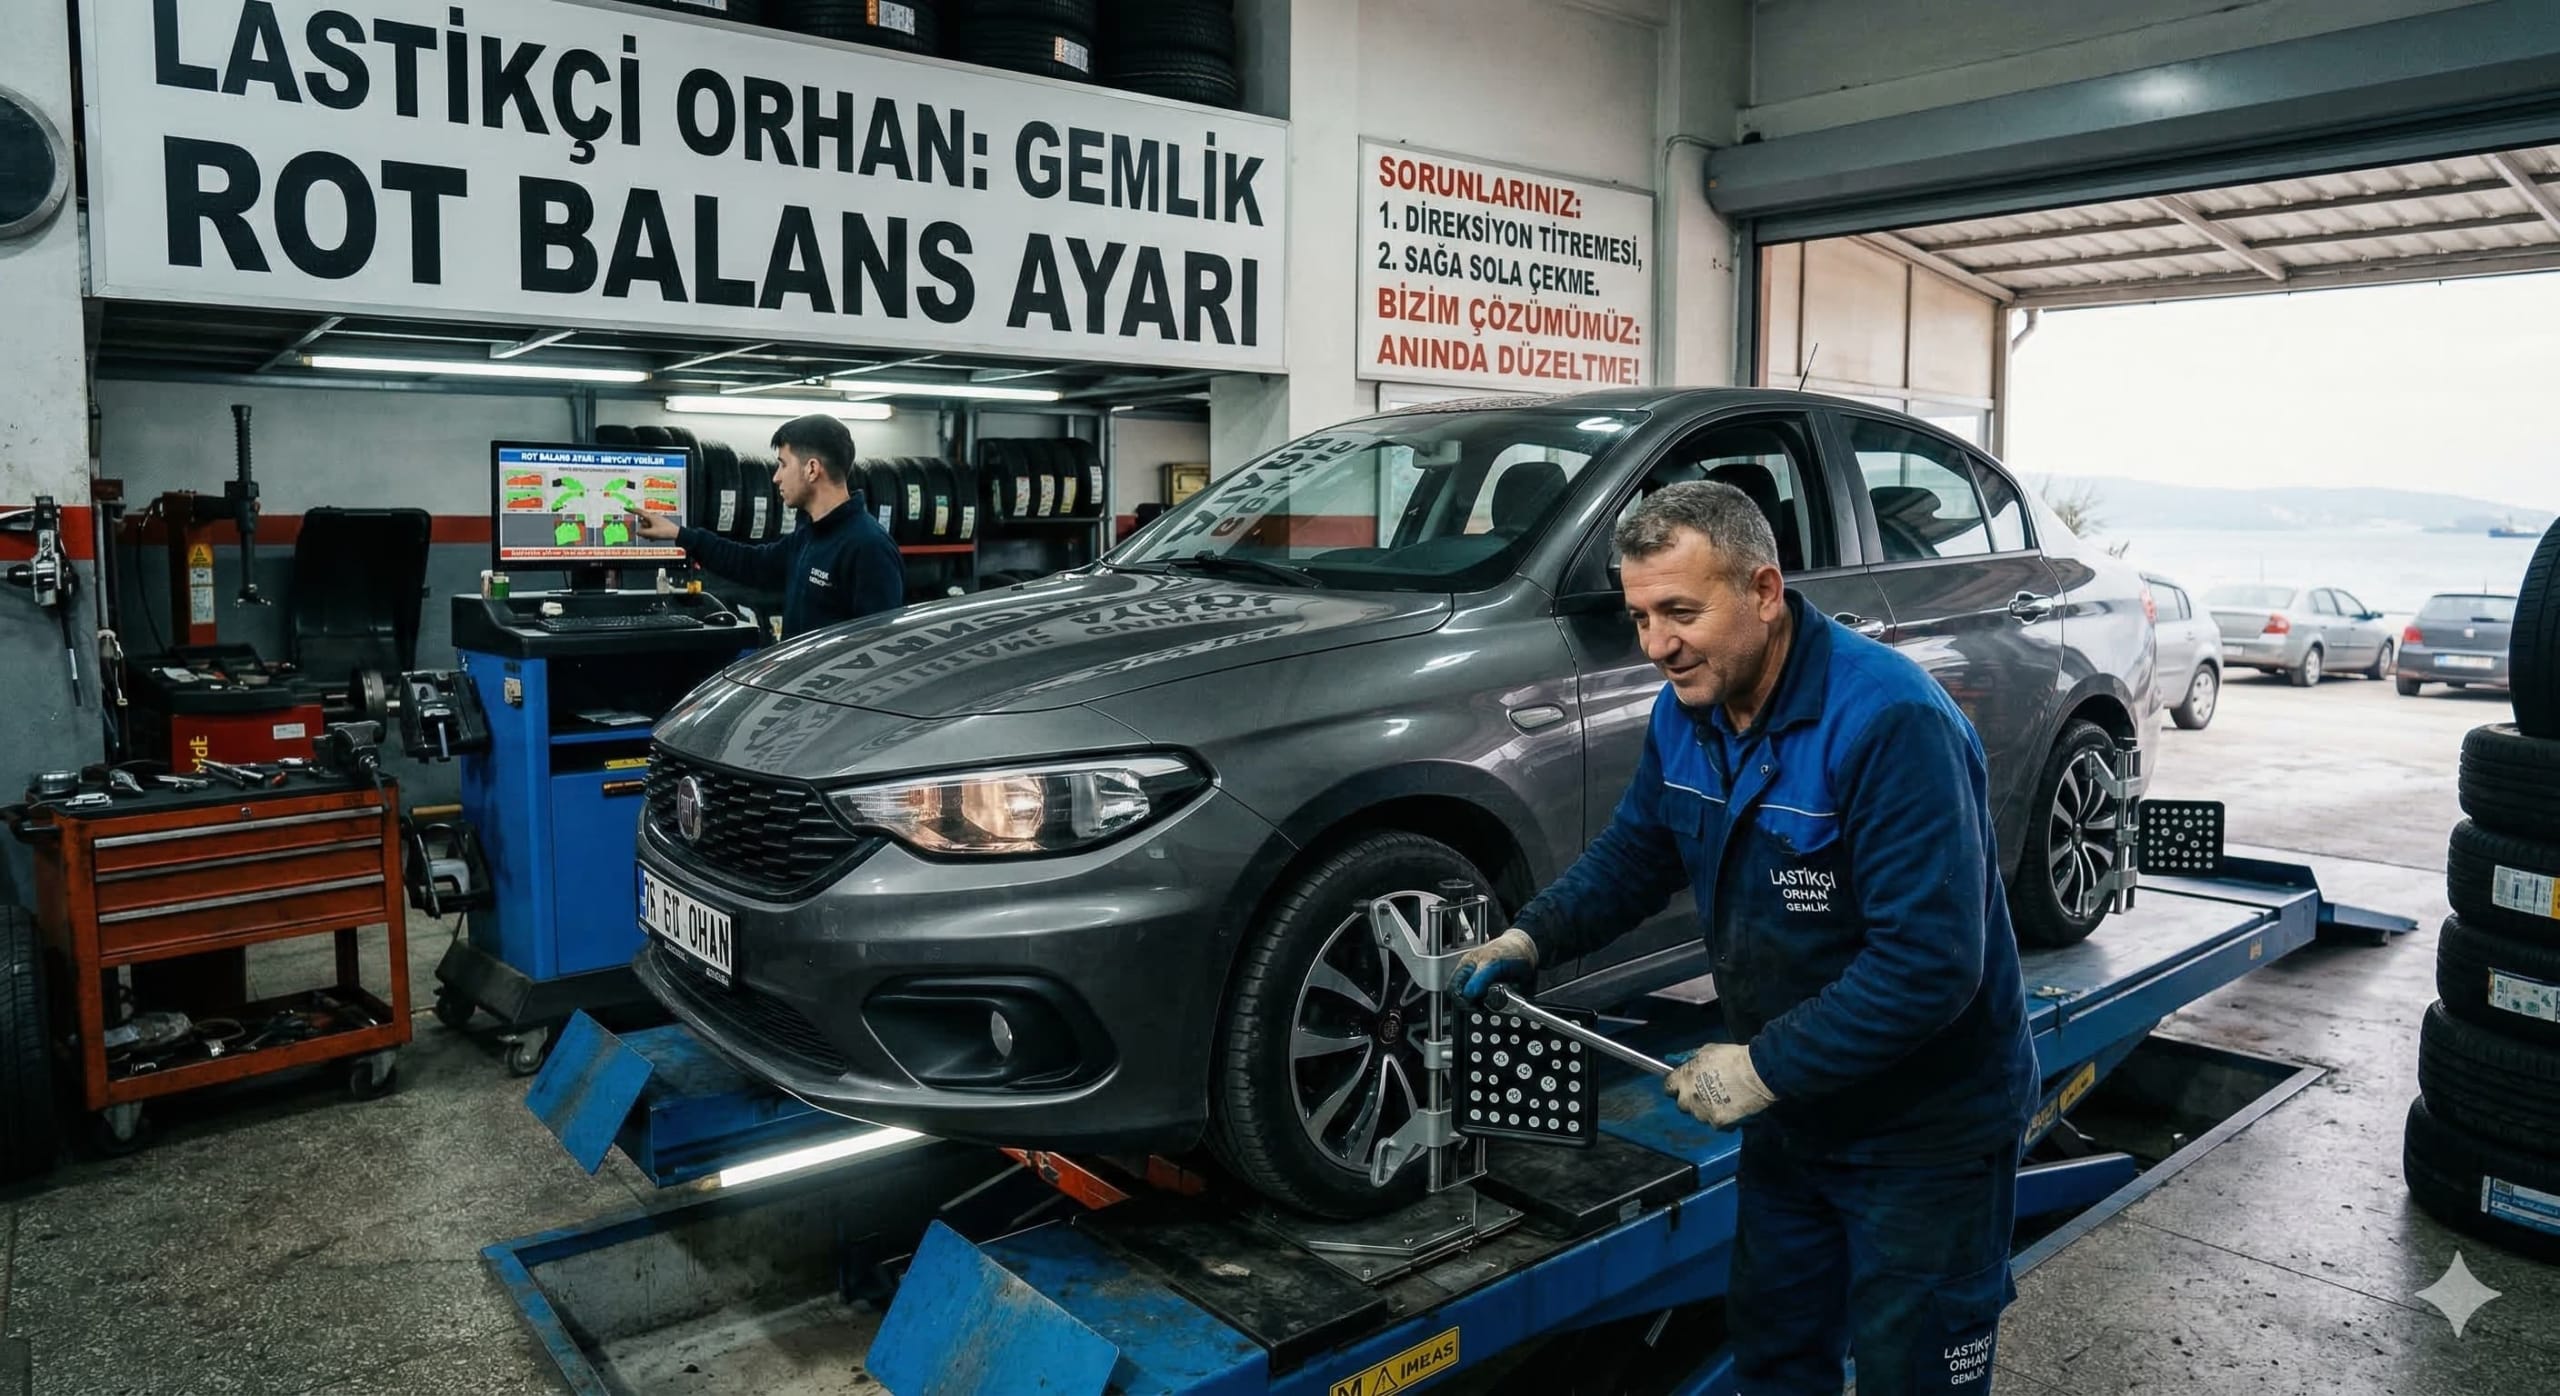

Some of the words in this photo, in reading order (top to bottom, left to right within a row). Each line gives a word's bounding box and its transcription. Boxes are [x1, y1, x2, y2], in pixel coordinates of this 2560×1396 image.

[153, 0, 642, 164] LASTİKÇİ
[677, 68, 988, 190] ORHAN:
[1015, 121, 1264, 227] GEMLİK
[1379, 155, 1582, 219] SORUNLARINIZ:
[163, 135, 468, 285] ROT
[519, 176, 975, 324] BALANS
[1006, 233, 1258, 347] AYARI
[1379, 201, 1398, 230] 1.
[1405, 201, 1532, 249] DİREKSİYON
[1539, 222, 1643, 273] TİTREMESİ,
[1378, 241, 1398, 270] 2.
[1405, 243, 1463, 279] SAĞA
[1469, 255, 1522, 287] SOLA
[1529, 263, 1600, 297] ÇEKME.
[1377, 281, 1459, 326] BİZİM
[1468, 294, 1641, 346] ÇÖZÜMÜMÜZ:
[1377, 334, 1489, 374] ANINDA
[1498, 341, 1640, 385] DÜZELTME!
[1782, 888, 1828, 900] ORHAN
[1786, 901, 1831, 912] GEMLİK
[688, 904, 729, 968] OHAN
[1400, 1341, 1454, 1379] IMEAS
[1949, 1351, 1988, 1372] ORHAN
